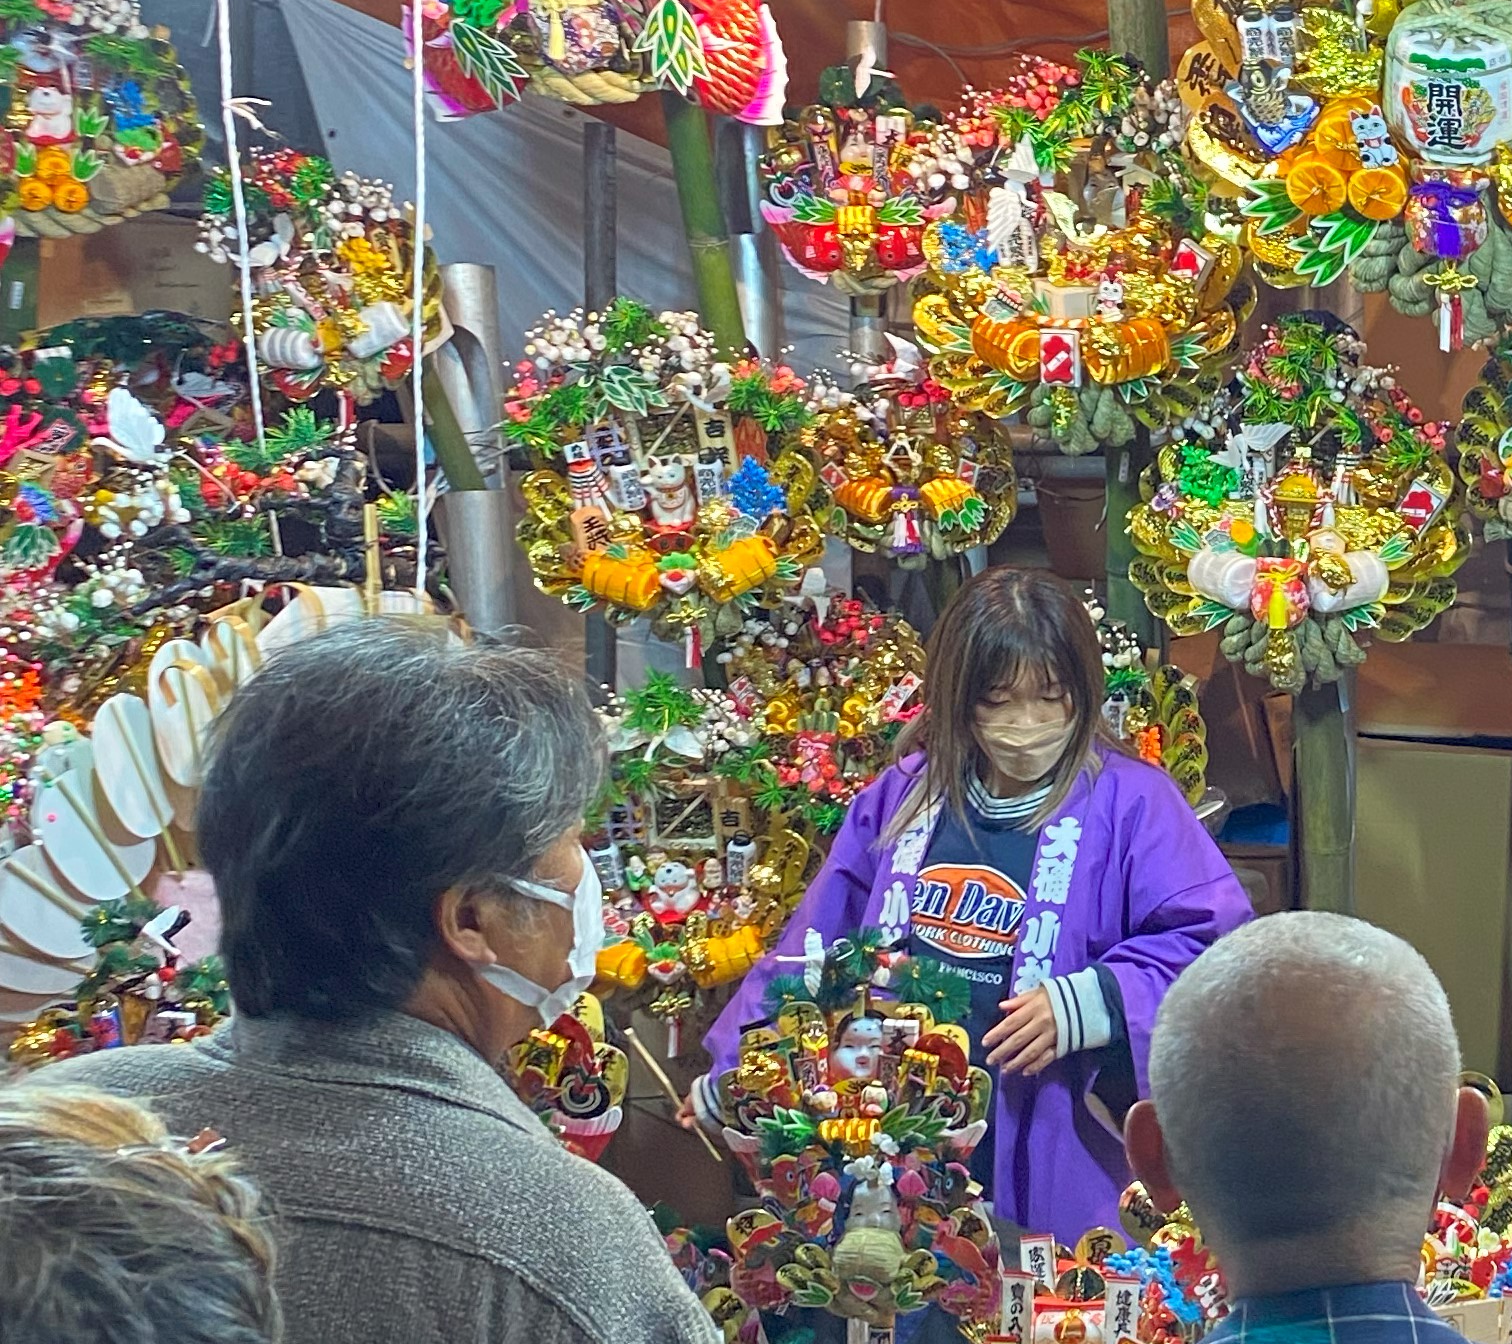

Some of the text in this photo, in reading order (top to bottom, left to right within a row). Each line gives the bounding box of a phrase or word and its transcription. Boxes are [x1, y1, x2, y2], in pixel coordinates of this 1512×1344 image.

[1427, 83, 1467, 150] 開運
[911, 878, 1027, 934] en Dav
[911, 922, 945, 941] ORK
